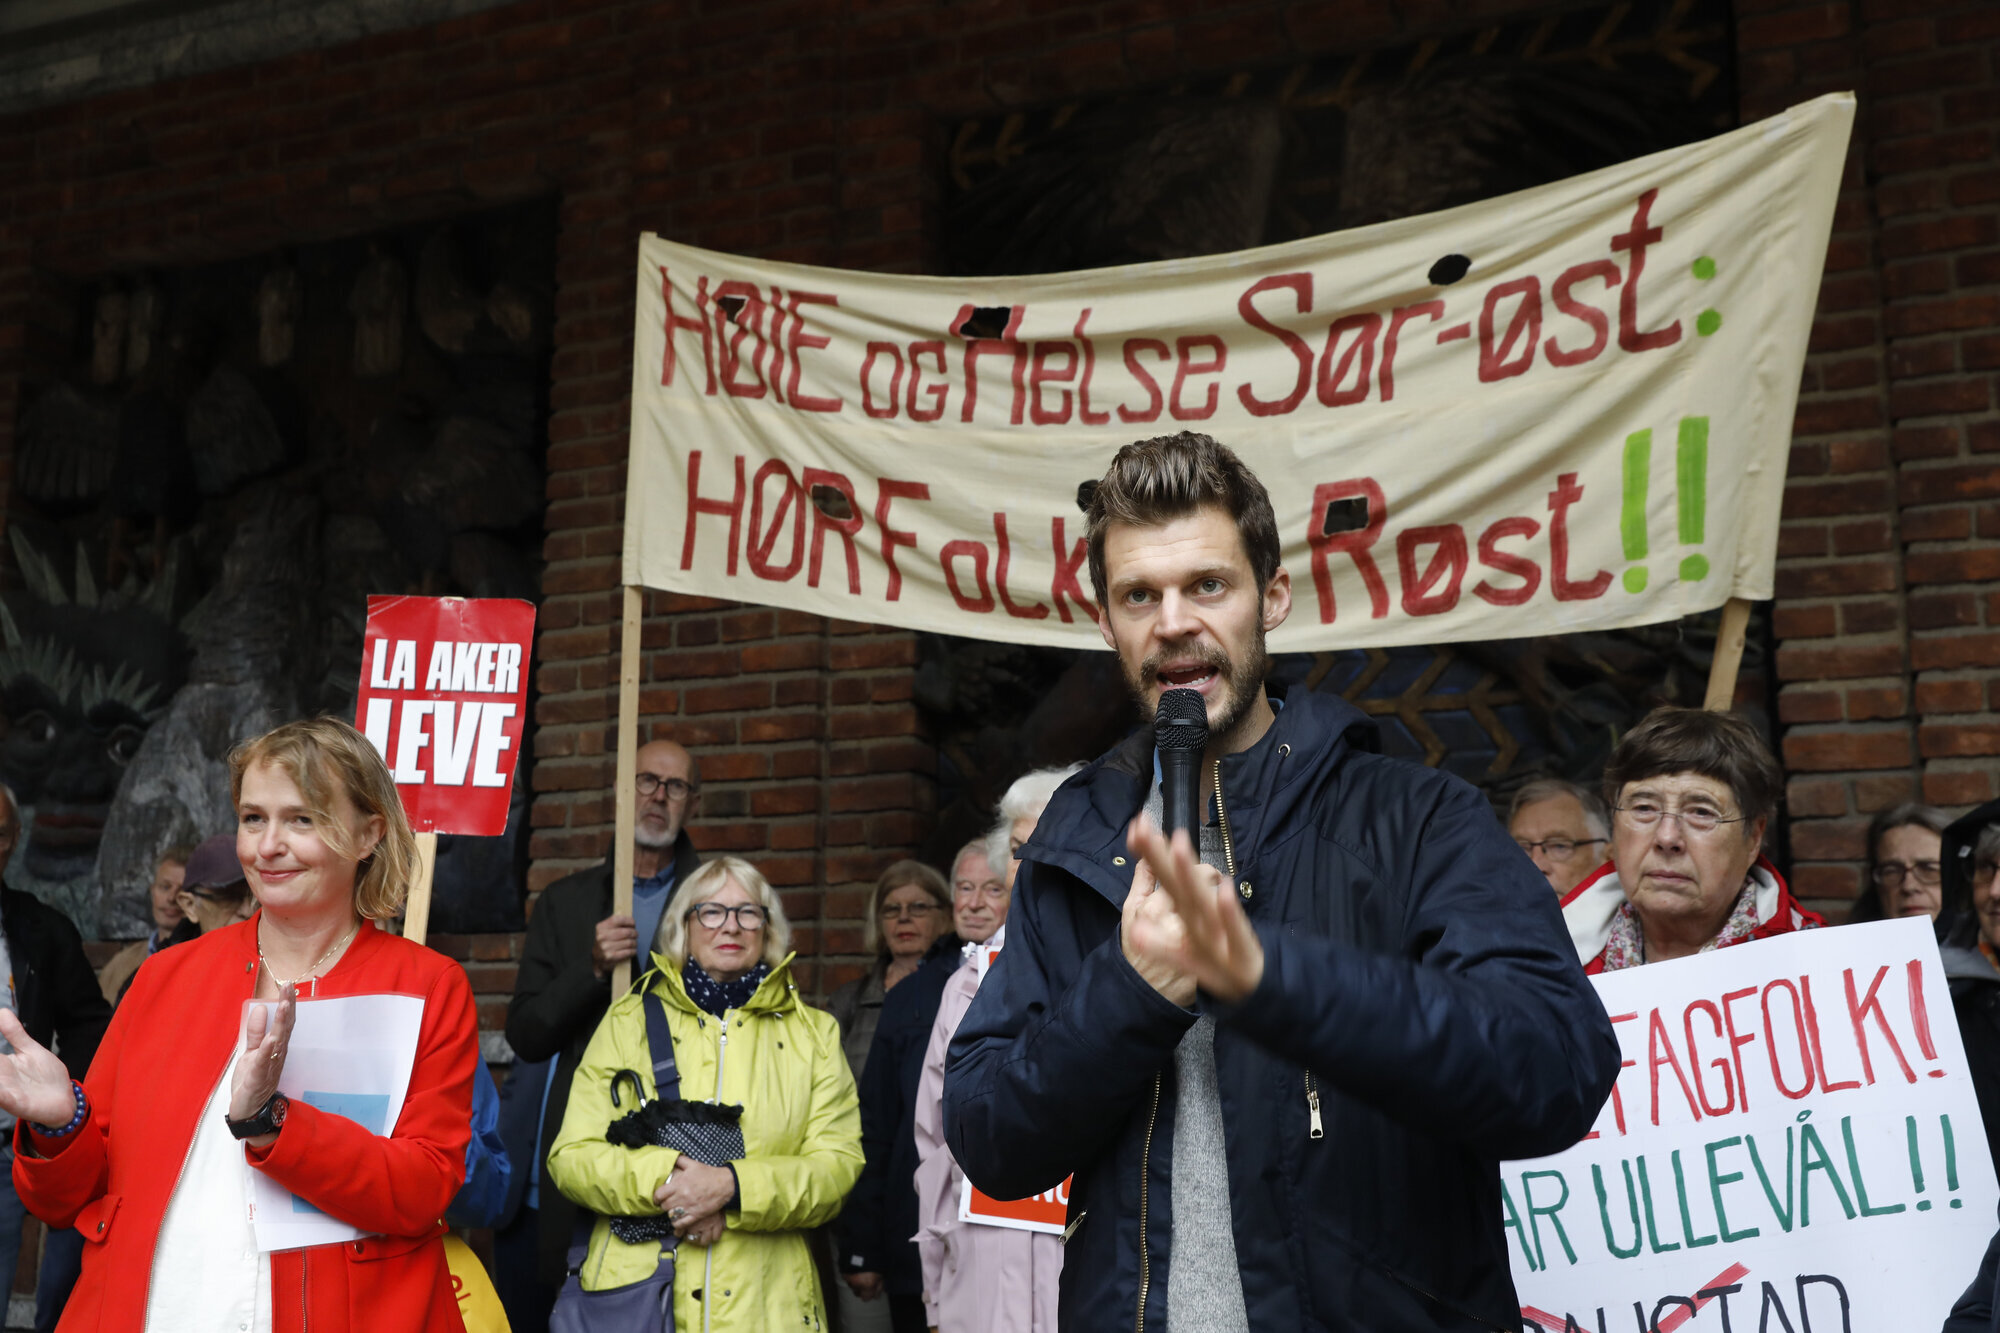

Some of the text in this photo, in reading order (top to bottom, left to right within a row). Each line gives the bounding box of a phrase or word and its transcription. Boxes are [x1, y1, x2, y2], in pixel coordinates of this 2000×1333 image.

[680, 450, 862, 596] HØR
[370, 638, 522, 693] LA AKER
[364, 698, 517, 787] LEVE
[1591, 1110, 1964, 1260] ULLEVÅL!!
